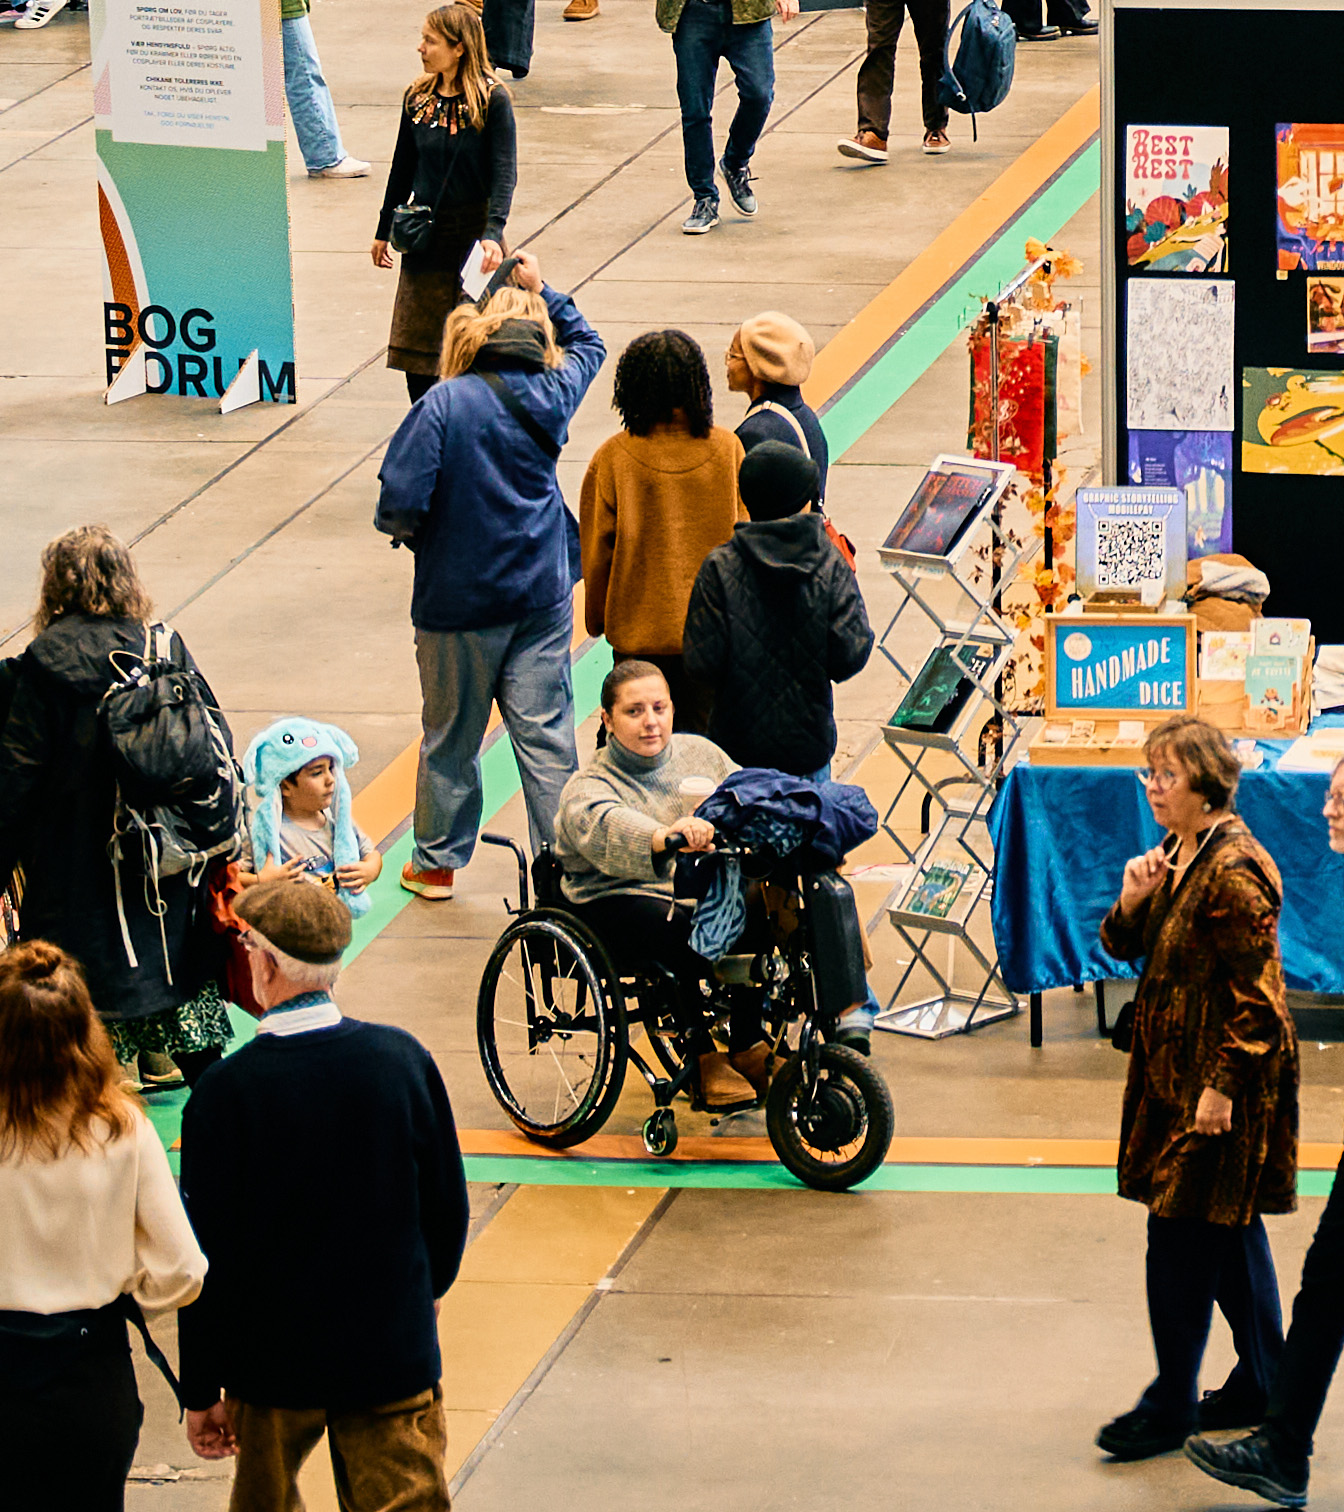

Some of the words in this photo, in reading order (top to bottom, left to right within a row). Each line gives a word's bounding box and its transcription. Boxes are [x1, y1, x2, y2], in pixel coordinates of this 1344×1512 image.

[104, 302, 216, 352] BOG
[1083, 492, 1119, 504] GRAPHIC
[1121, 492, 1179, 505] STORYTELLING
[1071, 637, 1171, 699] HANDMADE
[1139, 681, 1183, 705] DICE
